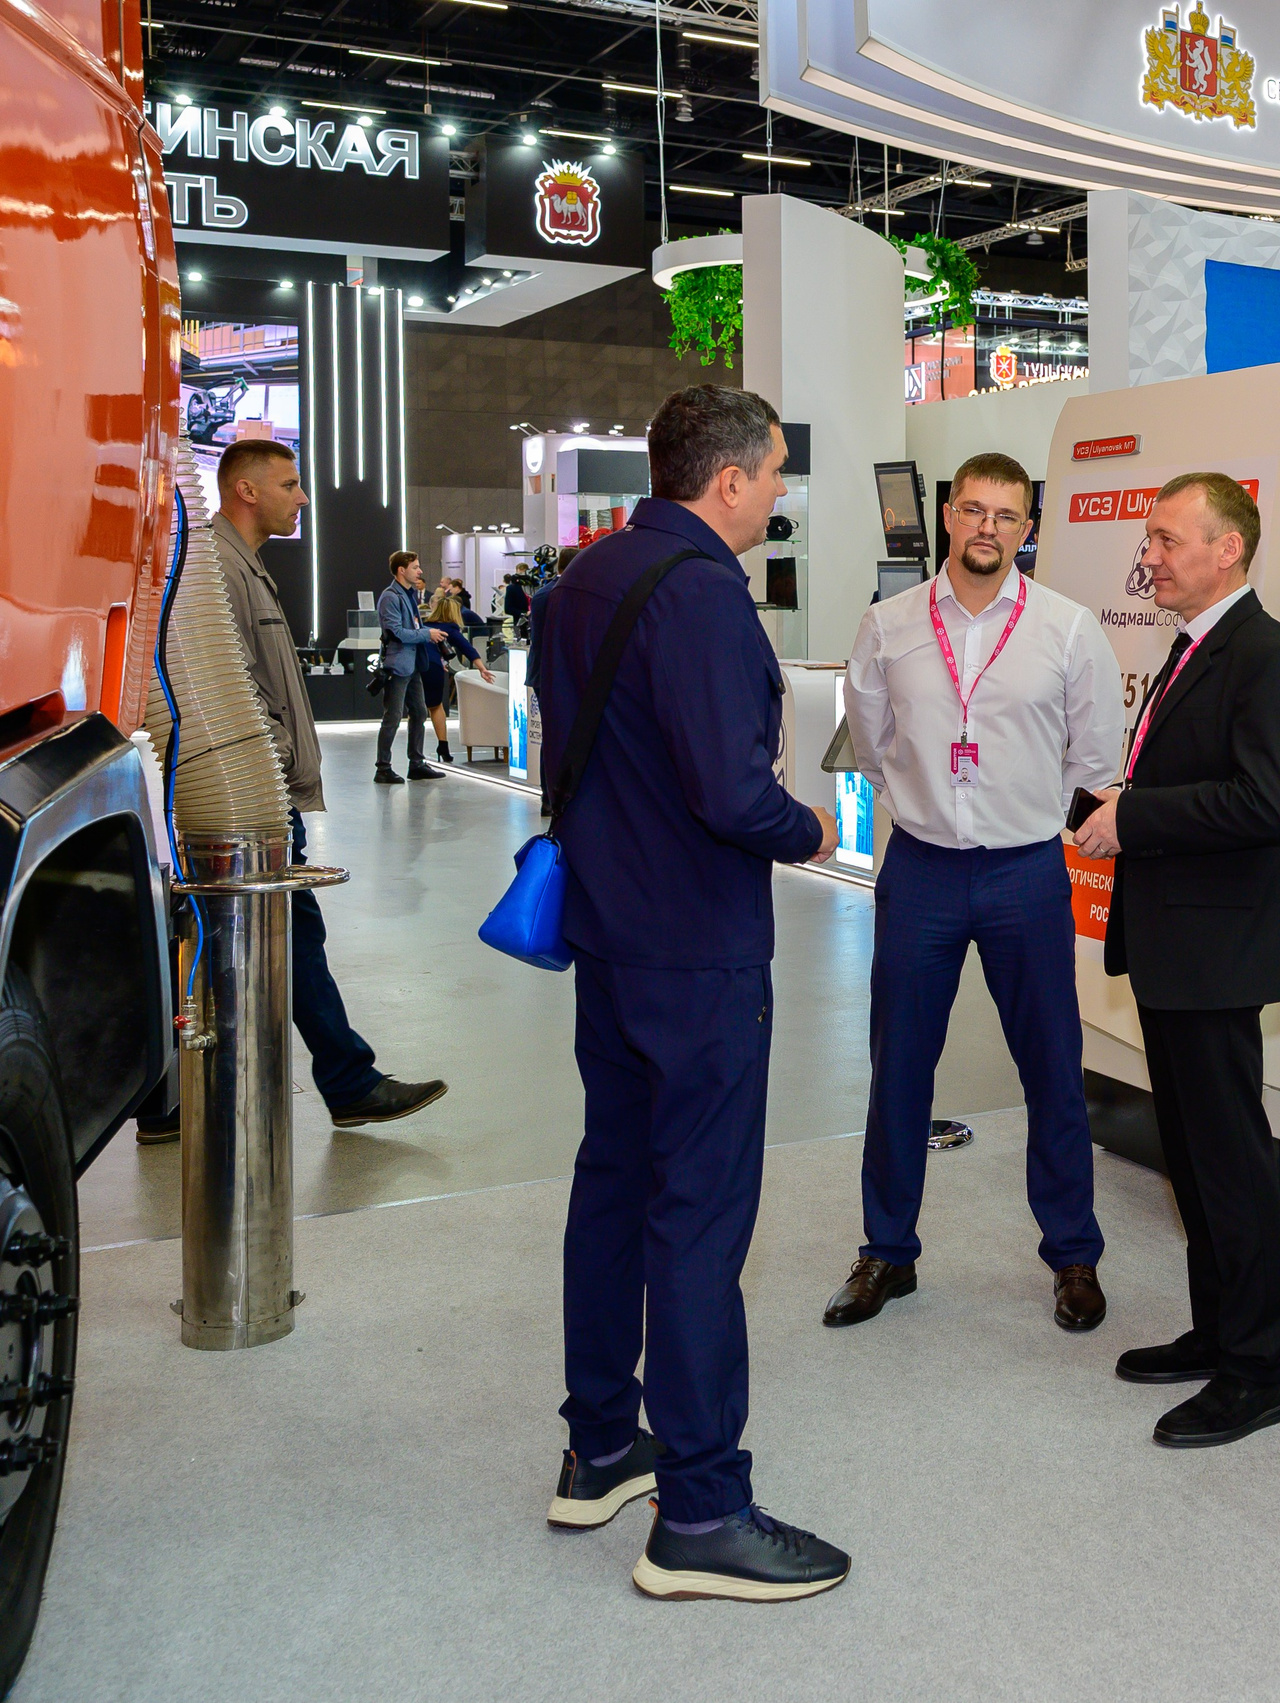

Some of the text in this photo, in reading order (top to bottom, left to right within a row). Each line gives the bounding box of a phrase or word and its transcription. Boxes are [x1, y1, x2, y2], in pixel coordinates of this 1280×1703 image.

[144, 101, 419, 179] ИНСКАЯ
[164, 172, 248, 228] ТЬ
[1092, 442, 1123, 455] Ulyanovsk
[1100, 608, 1182, 628] МодмашСоф
[1066, 867, 1114, 892] ОГИЧЕСК
[1089, 903, 1109, 923] РОС
